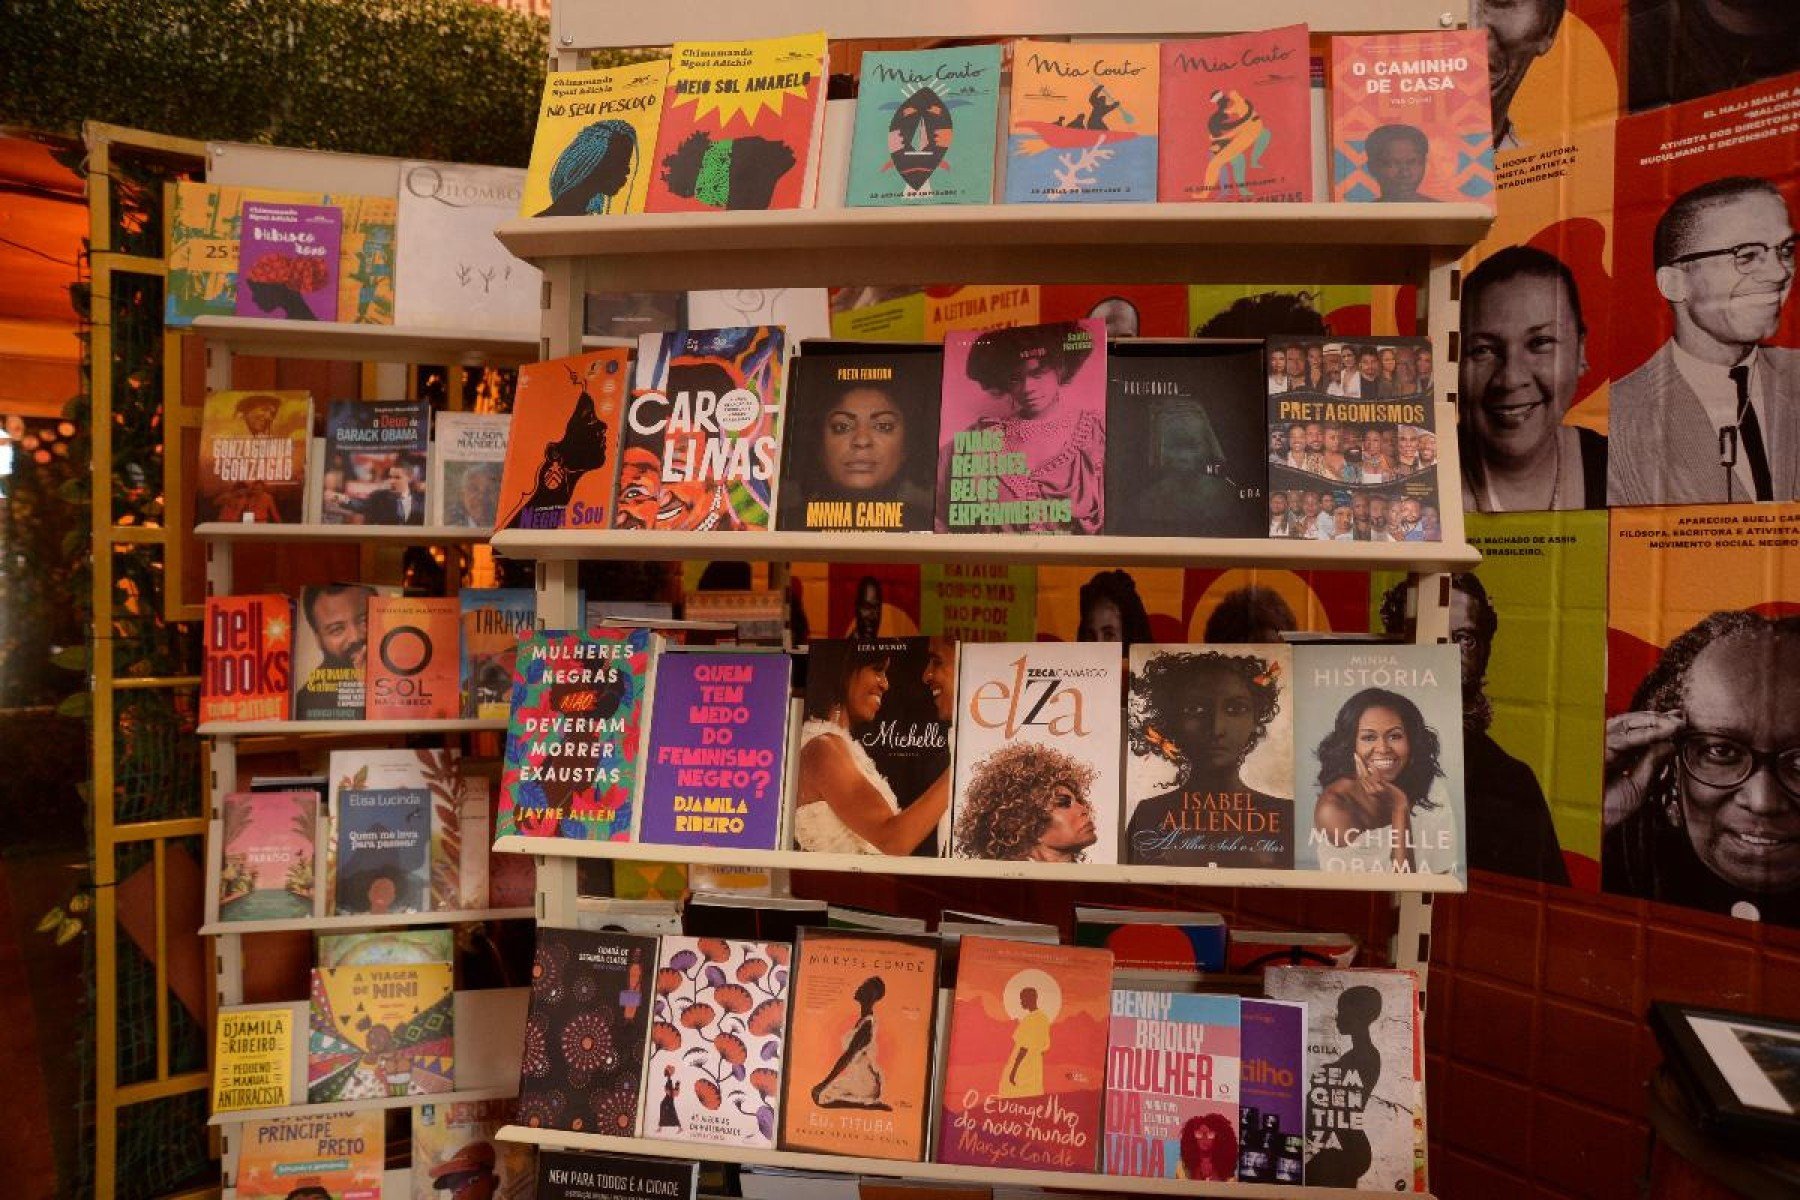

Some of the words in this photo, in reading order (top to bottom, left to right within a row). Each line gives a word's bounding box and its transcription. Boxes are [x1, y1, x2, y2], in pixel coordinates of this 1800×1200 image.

[1027, 53, 1089, 77] Mia
[1093, 59, 1146, 77] Couto
[1174, 52, 1239, 73] Mia
[1241, 49, 1296, 67] Couto
[1352, 62, 1366, 76] O
[1374, 58, 1468, 75] CAMINHO
[873, 62, 934, 83] Mia
[935, 61, 986, 80] Couto
[675, 78, 711, 95] MEIO
[715, 78, 741, 94] SOL
[745, 71, 811, 93] AMARELO
[1366, 79, 1391, 94] DE
[1399, 76, 1455, 92] CASA
[547, 103, 566, 118] NO
[568, 102, 595, 117] SEU
[1660, 134, 1707, 150] ATIVISTA
[206, 245, 228, 258] 25
[1280, 401, 1425, 424] PRETAGONISMOS
[337, 428, 378, 441] BARACK
[381, 428, 418, 441] OBAMA
[662, 437, 775, 482] LINAS
[807, 502, 852, 527] MINHA
[857, 502, 903, 527] CARNE
[1678, 517, 1738, 525] APARECIDA
[1650, 540, 1711, 548] MOVIMENTO
[1716, 539, 1755, 547] SOCIAL
[212, 602, 263, 651] bell
[380, 626, 433, 676] O
[532, 644, 634, 661] MULHERES
[1351, 655, 1397, 666] MINHA
[543, 669, 618, 684] NEGRAS
[695, 665, 753, 682] QUEM
[1314, 664, 1438, 687] HISTÓRIA
[375, 678, 432, 696] SOL
[701, 686, 744, 703] TEM
[970, 653, 1091, 739] elza
[690, 707, 749, 724] MEDO
[526, 718, 625, 733] DEVERIAM
[862, 719, 947, 748] Michelle
[702, 729, 732, 745] DO
[531, 743, 615, 757] MORRER
[658, 747, 774, 767] FEMINISMO
[520, 766, 620, 783] EXAUSTAS
[678, 769, 771, 798] NEGRO?
[674, 796, 747, 814] DJAMILA
[1184, 791, 1256, 811] ISABEL
[517, 808, 563, 821] JAYNE
[570, 807, 616, 821] ALLEN
[1162, 810, 1280, 833] ALLENDE
[675, 816, 744, 833] RIBEIRO
[1308, 827, 1452, 851] MICHELLE
[1327, 857, 1432, 875] OBAMA
[354, 972, 363, 982] A
[371, 971, 419, 982] VIAGEM
[372, 983, 418, 999] NINI
[1112, 990, 1172, 1017] BENNY
[224, 1020, 283, 1038] DJAMILA
[229, 1037, 276, 1053] RIBEIRO
[233, 1062, 271, 1074] PEQUENO
[1108, 1046, 1212, 1099] MULHER
[233, 1074, 269, 1086] MANUAL
[1312, 1067, 1364, 1088] SEM
[218, 1086, 285, 1107] ANTIRRACISTA
[963, 1090, 979, 1109] O
[984, 1094, 1079, 1126] Evangelho
[1312, 1108, 1364, 1130] TILE
[954, 1114, 975, 1130] do
[983, 1117, 1021, 1138] novo
[1026, 1123, 1087, 1147] mundo
[318, 1138, 364, 1156] PRETO
[1104, 1134, 1165, 1178] VIDA
[549, 1169, 567, 1185] NEM
[570, 1171, 594, 1188] PARA
[597, 1173, 627, 1191] TODOS
[637, 1178, 643, 1192] A
[646, 1179, 679, 1197] CIDADE
